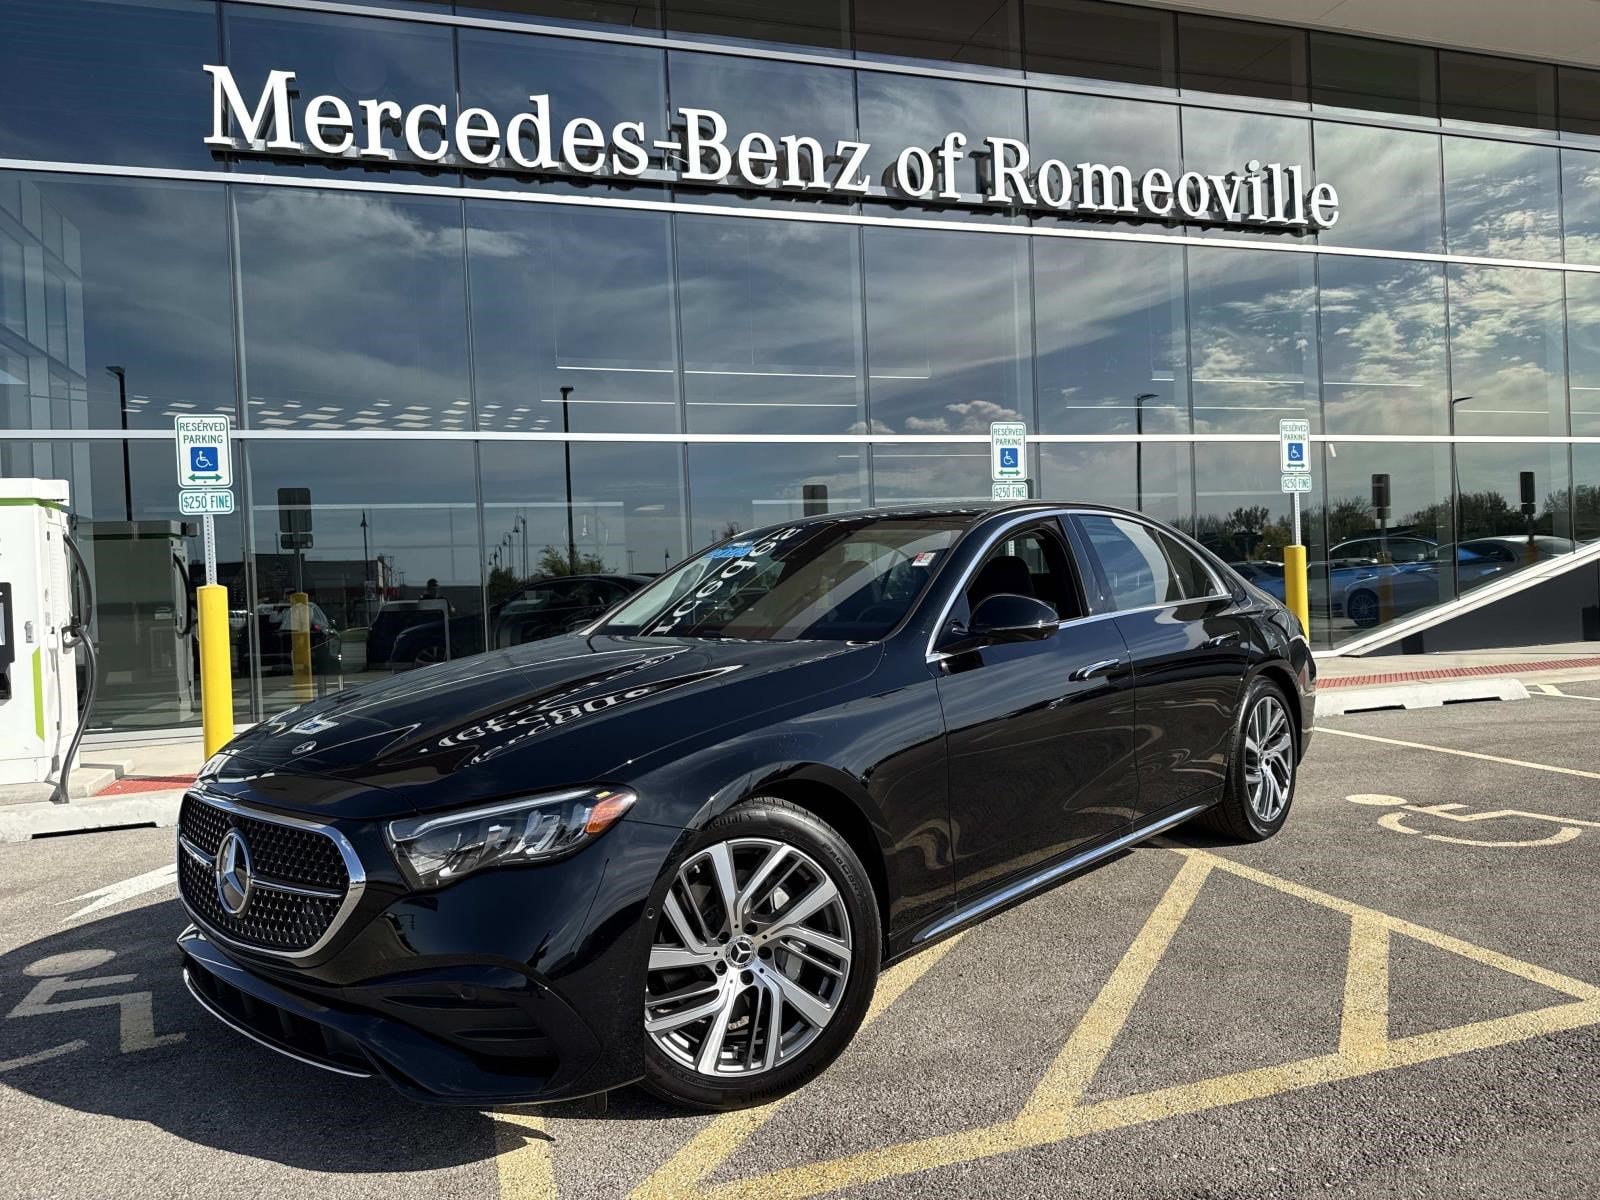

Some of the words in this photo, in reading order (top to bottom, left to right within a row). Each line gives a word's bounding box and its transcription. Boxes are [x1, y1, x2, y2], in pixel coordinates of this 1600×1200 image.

[203, 64, 870, 192] Mercedes-Benz
[898, 132, 967, 199] of
[986, 136, 1339, 227] Romeoville
[180, 422, 225, 432] RESERVED
[993, 428, 1023, 436] RESERVED
[183, 434, 223, 444] PARKING
[996, 438, 1021, 446] PARKING
[995, 486, 1010, 498] $250
[1012, 486, 1025, 498] FINE
[184, 495, 207, 509] $250
[210, 495, 230, 509] FINE
